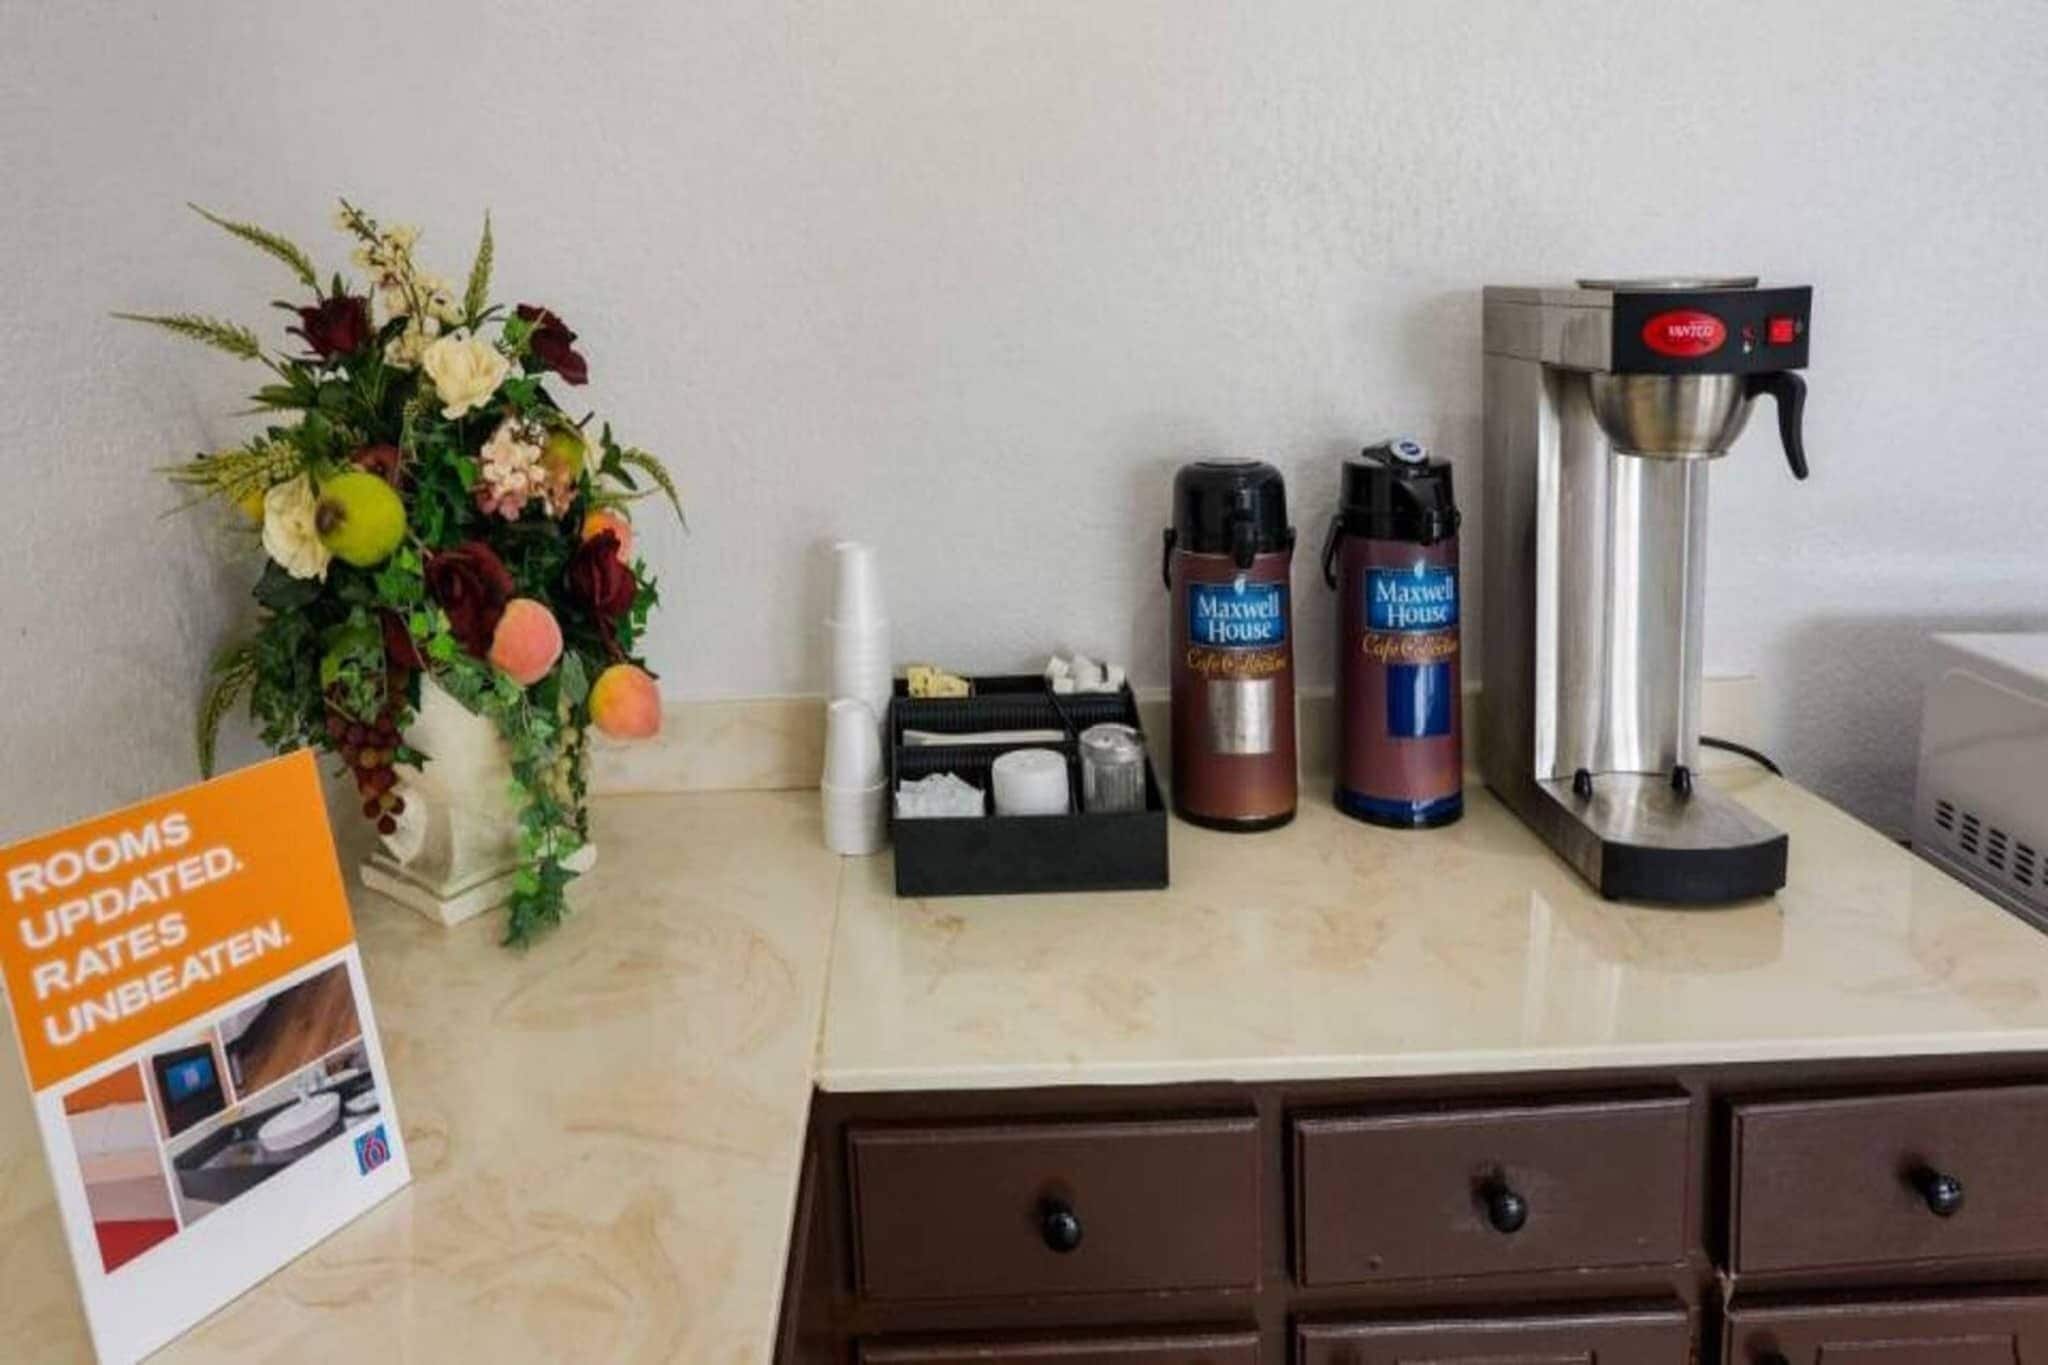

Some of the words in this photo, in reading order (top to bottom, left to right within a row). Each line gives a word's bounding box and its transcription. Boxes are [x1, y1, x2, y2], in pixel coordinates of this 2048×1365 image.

[1198, 591, 1280, 618] Maxwell
[1376, 575, 1454, 603] Maxwell
[1387, 602, 1449, 628] House
[1208, 619, 1272, 643] House
[6, 812, 192, 903] ROOMS
[18, 845, 245, 951] UPDATED.
[32, 911, 190, 1000] RATES
[43, 916, 293, 1047] UNBEATEN.
